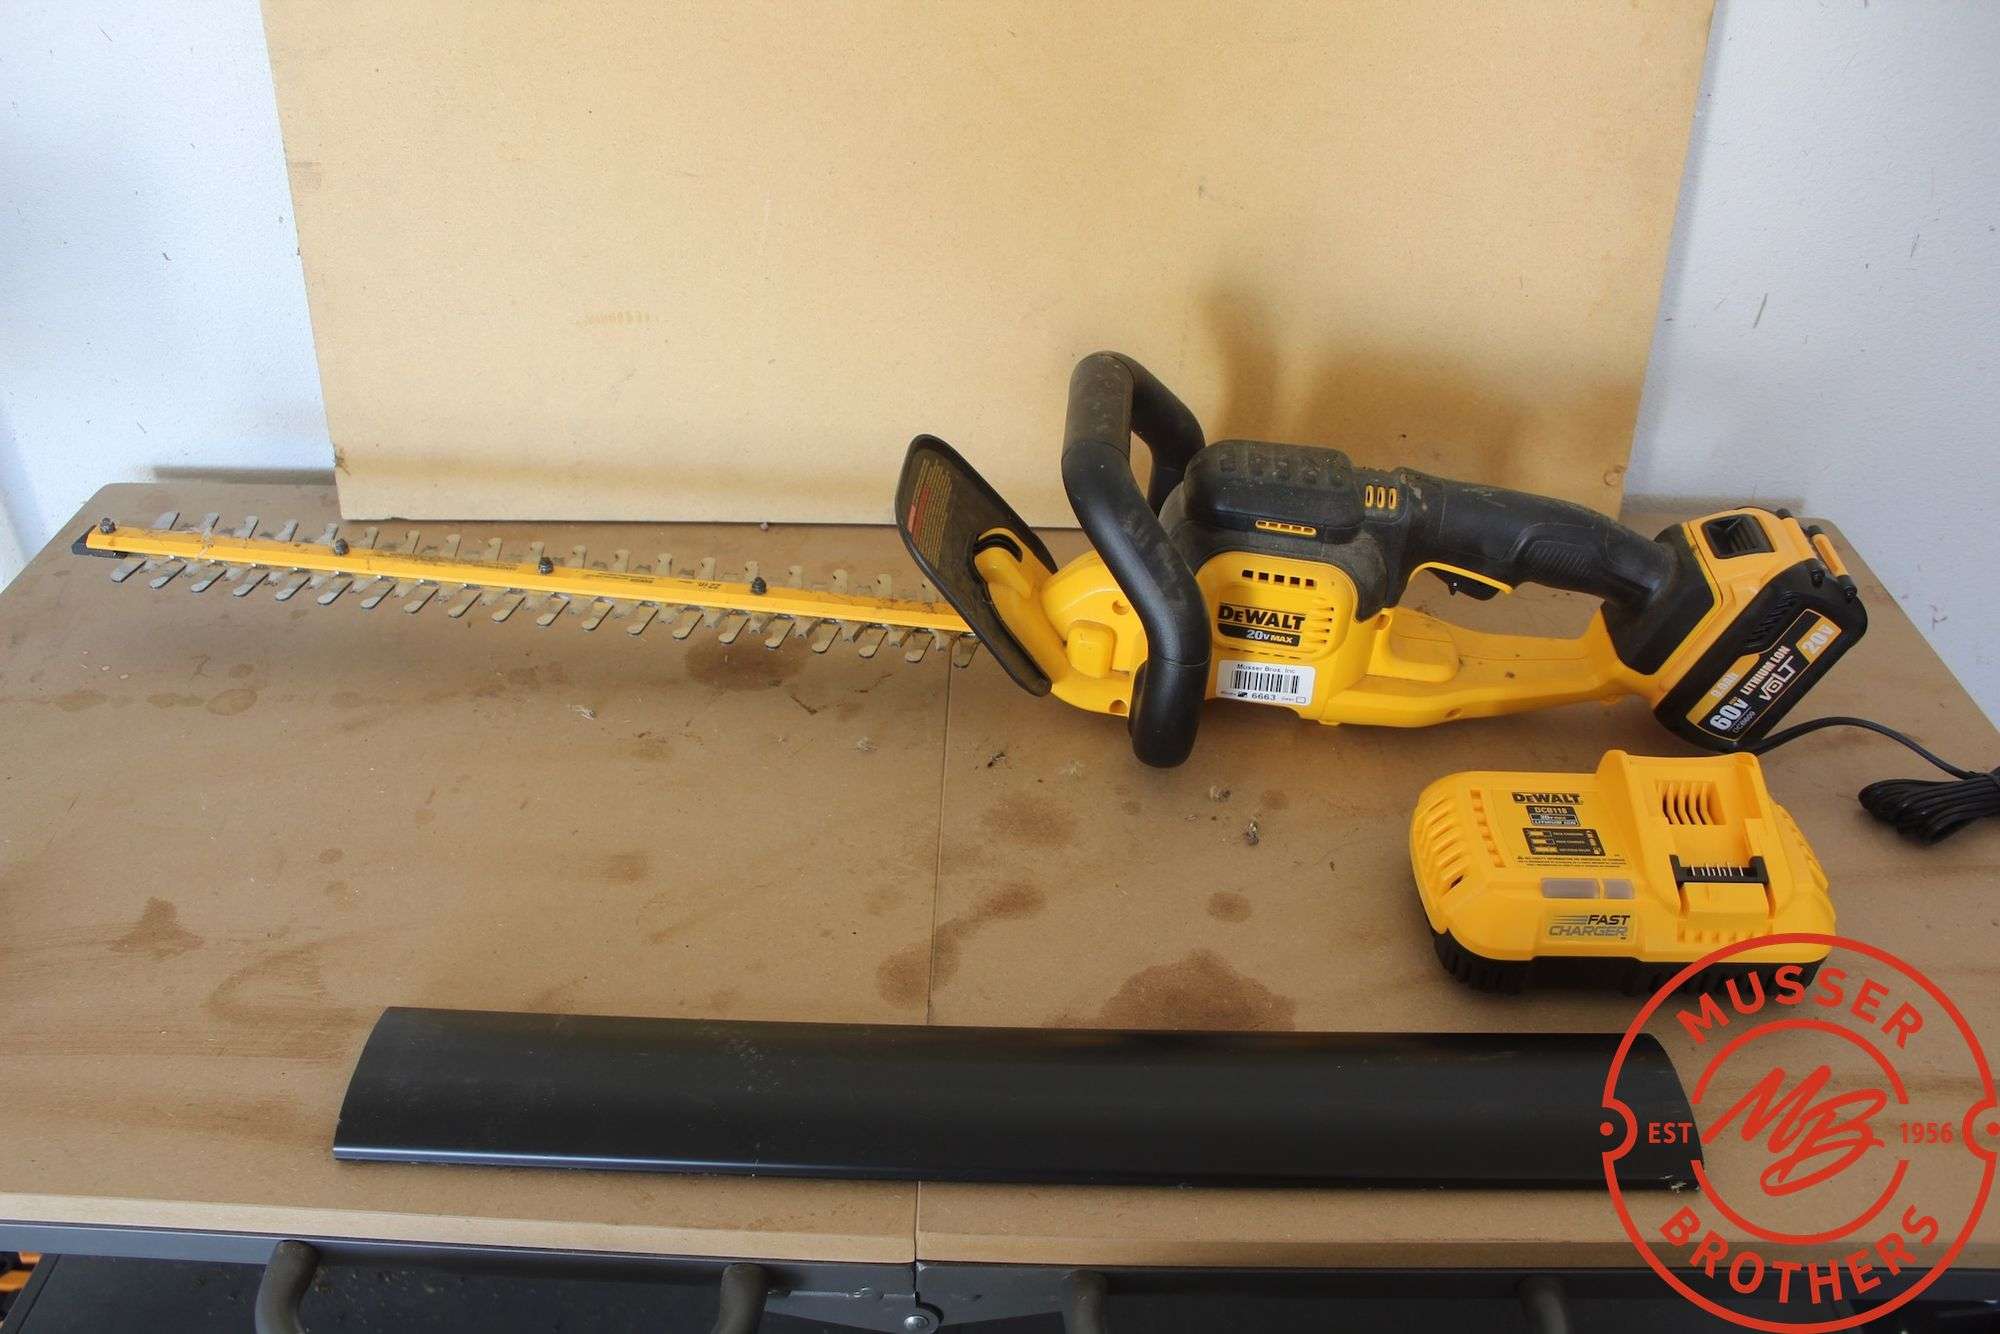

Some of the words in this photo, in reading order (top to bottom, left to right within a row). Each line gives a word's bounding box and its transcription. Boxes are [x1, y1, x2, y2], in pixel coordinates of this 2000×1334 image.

[1270, 635, 1294, 644] MAX
[1236, 663, 1262, 672] Musser
[1740, 656, 1776, 696] LITHIUM
[1759, 655, 1796, 701] VOLT
[1251, 692, 1277, 701] 6663
[1588, 914, 1631, 925] FAST
[1548, 925, 1628, 937] CHARGER
